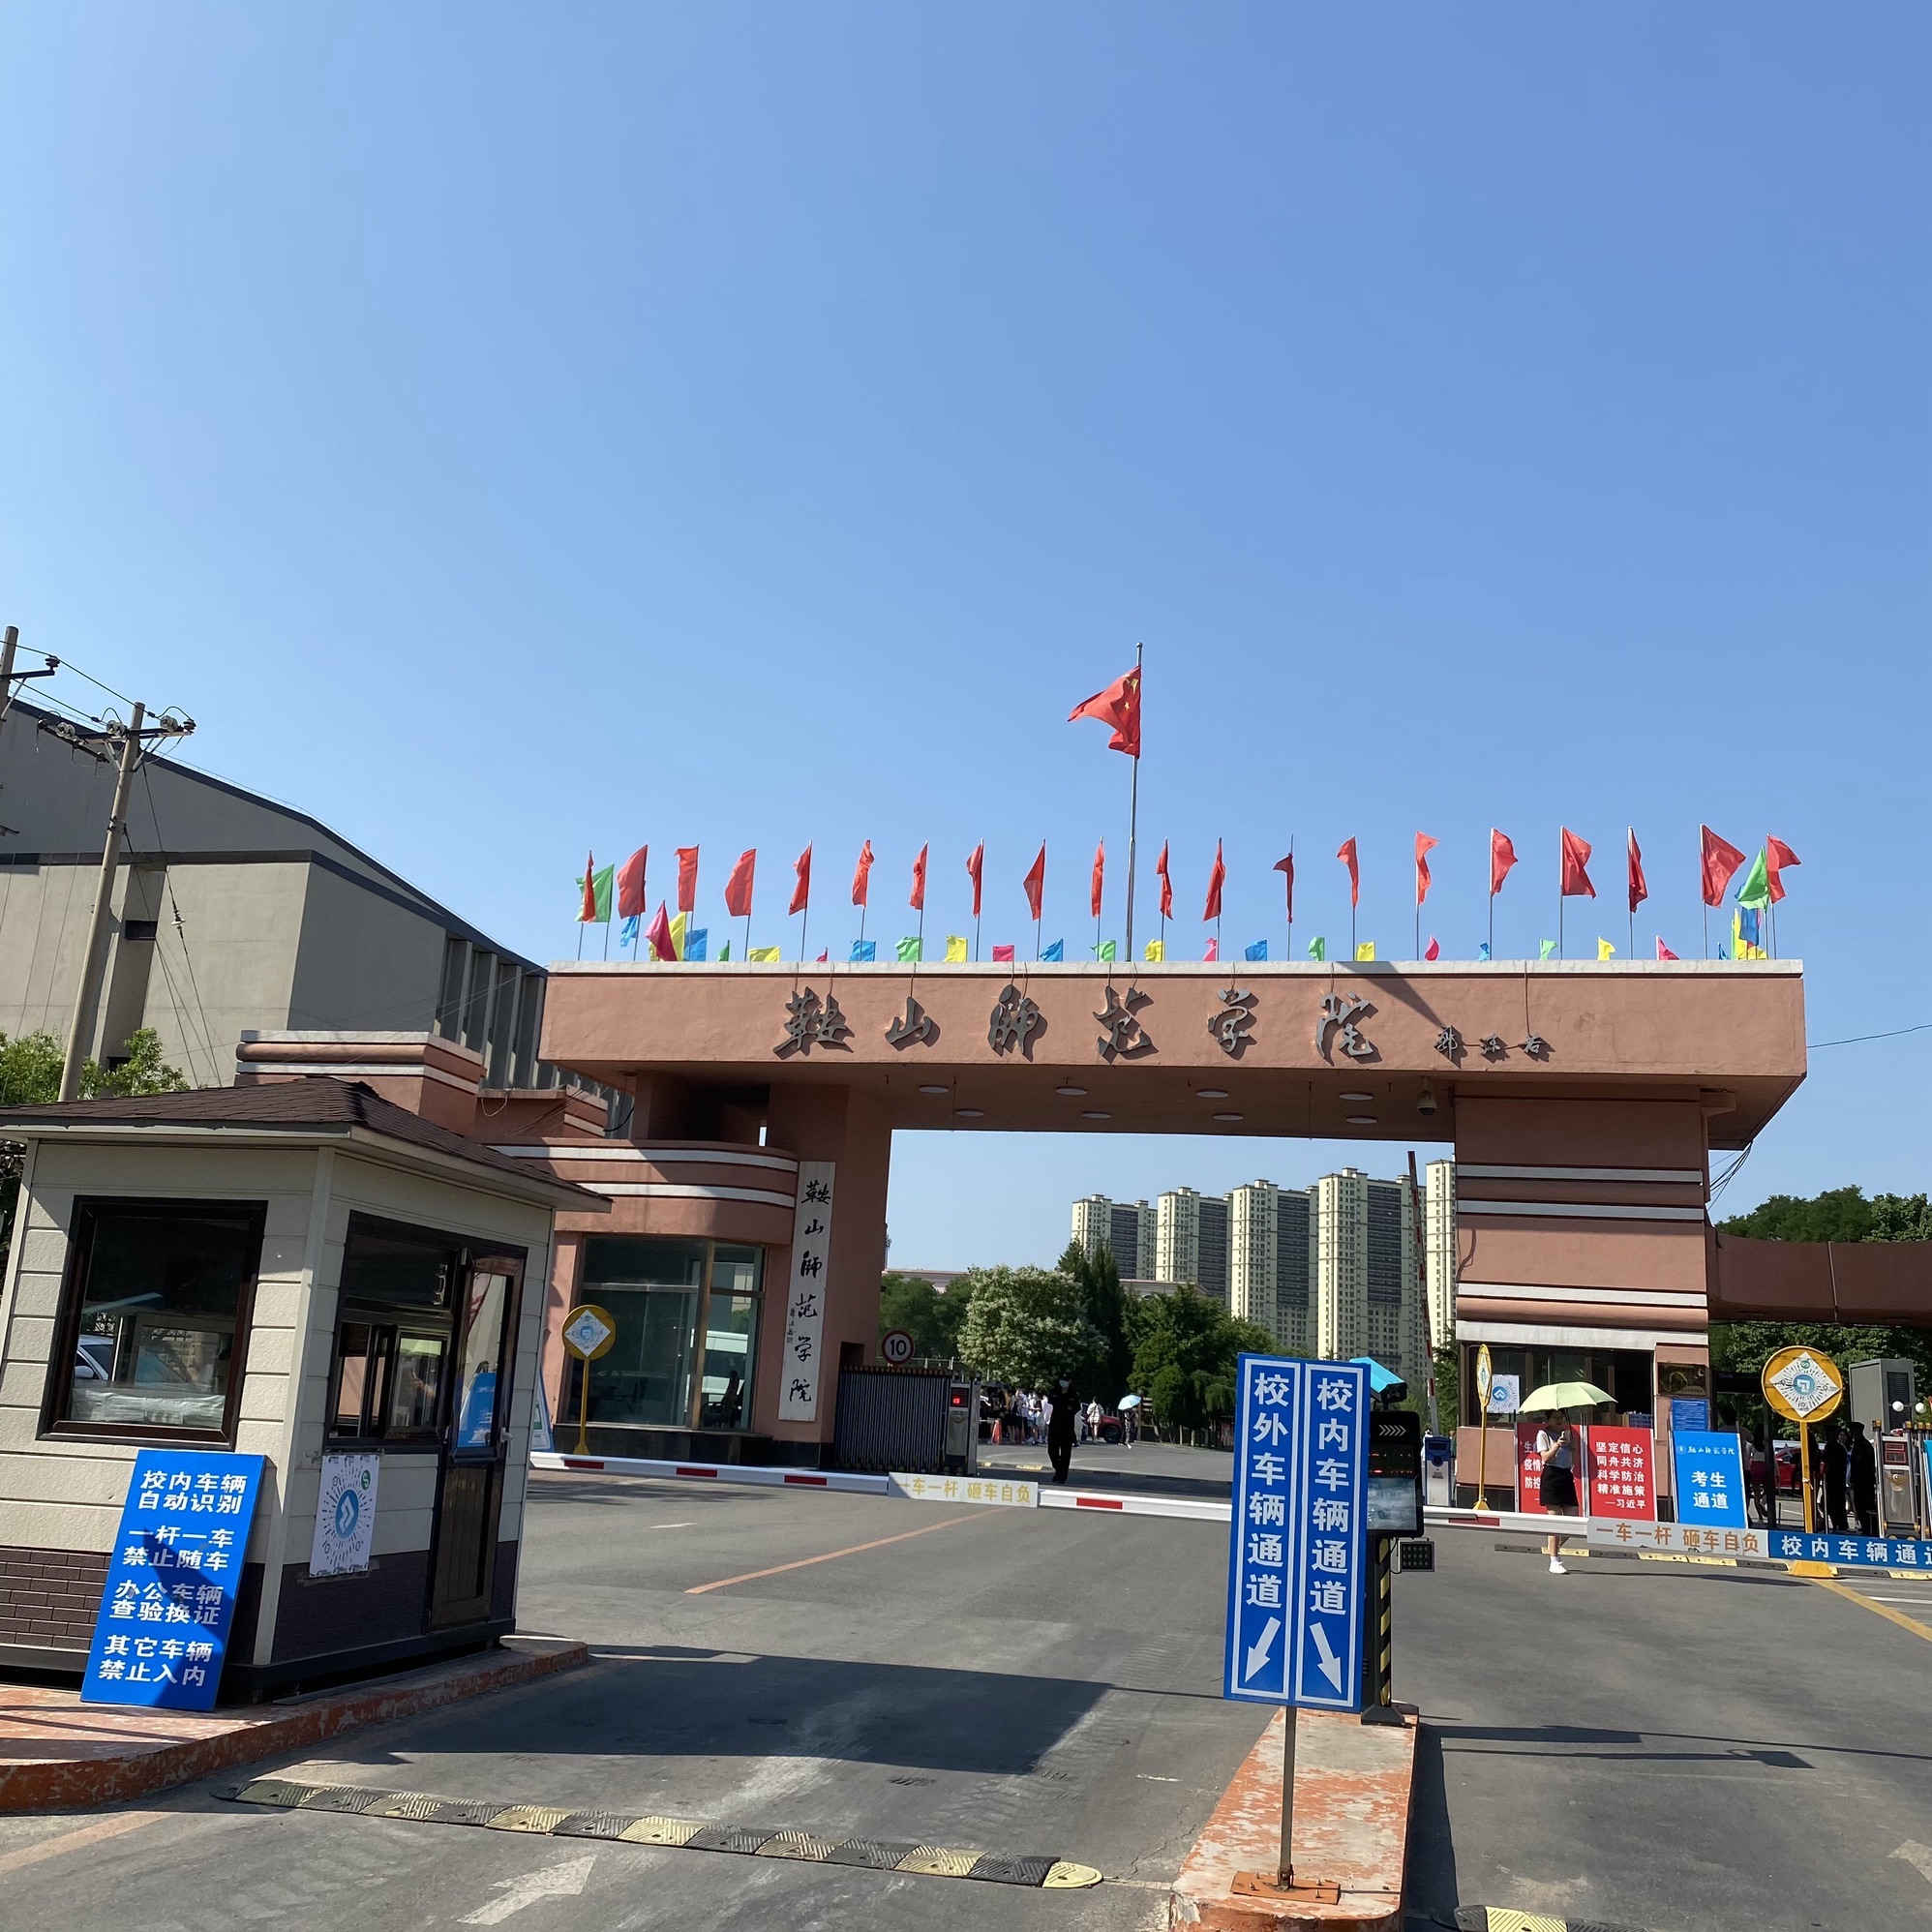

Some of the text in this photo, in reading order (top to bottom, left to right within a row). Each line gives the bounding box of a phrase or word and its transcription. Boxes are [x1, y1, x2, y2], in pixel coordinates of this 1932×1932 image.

[891, 1339, 907, 1356] 10
[1596, 1441, 1644, 1455] 坚定信心
[1596, 1455, 1644, 1468] 同舟共济
[140, 1469, 248, 1494] 校内车辆
[1597, 1469, 1645, 1483] 科学防治
[1691, 1470, 1727, 1488] 考生
[897, 1477, 1030, 1503] 一车一杆 砸车自负
[1246, 1373, 1289, 1609] 校外车辆通道
[1310, 1377, 1353, 1615] 校内车辆通道
[1597, 1482, 1645, 1496] 精准施策
[1693, 1492, 1729, 1509] 通道
[138, 1491, 242, 1515] 自动识别
[129, 1525, 234, 1549] 一杆一车
[1596, 1523, 1759, 1553] 一车一杆 砸车自负
[123, 1546, 229, 1571] 禁止随车
[115, 1580, 224, 1606] 办公车辆
[108, 1599, 221, 1625] 查验换证
[104, 1635, 214, 1663] 其它车辆
[98, 1659, 206, 1687] 禁止入内
